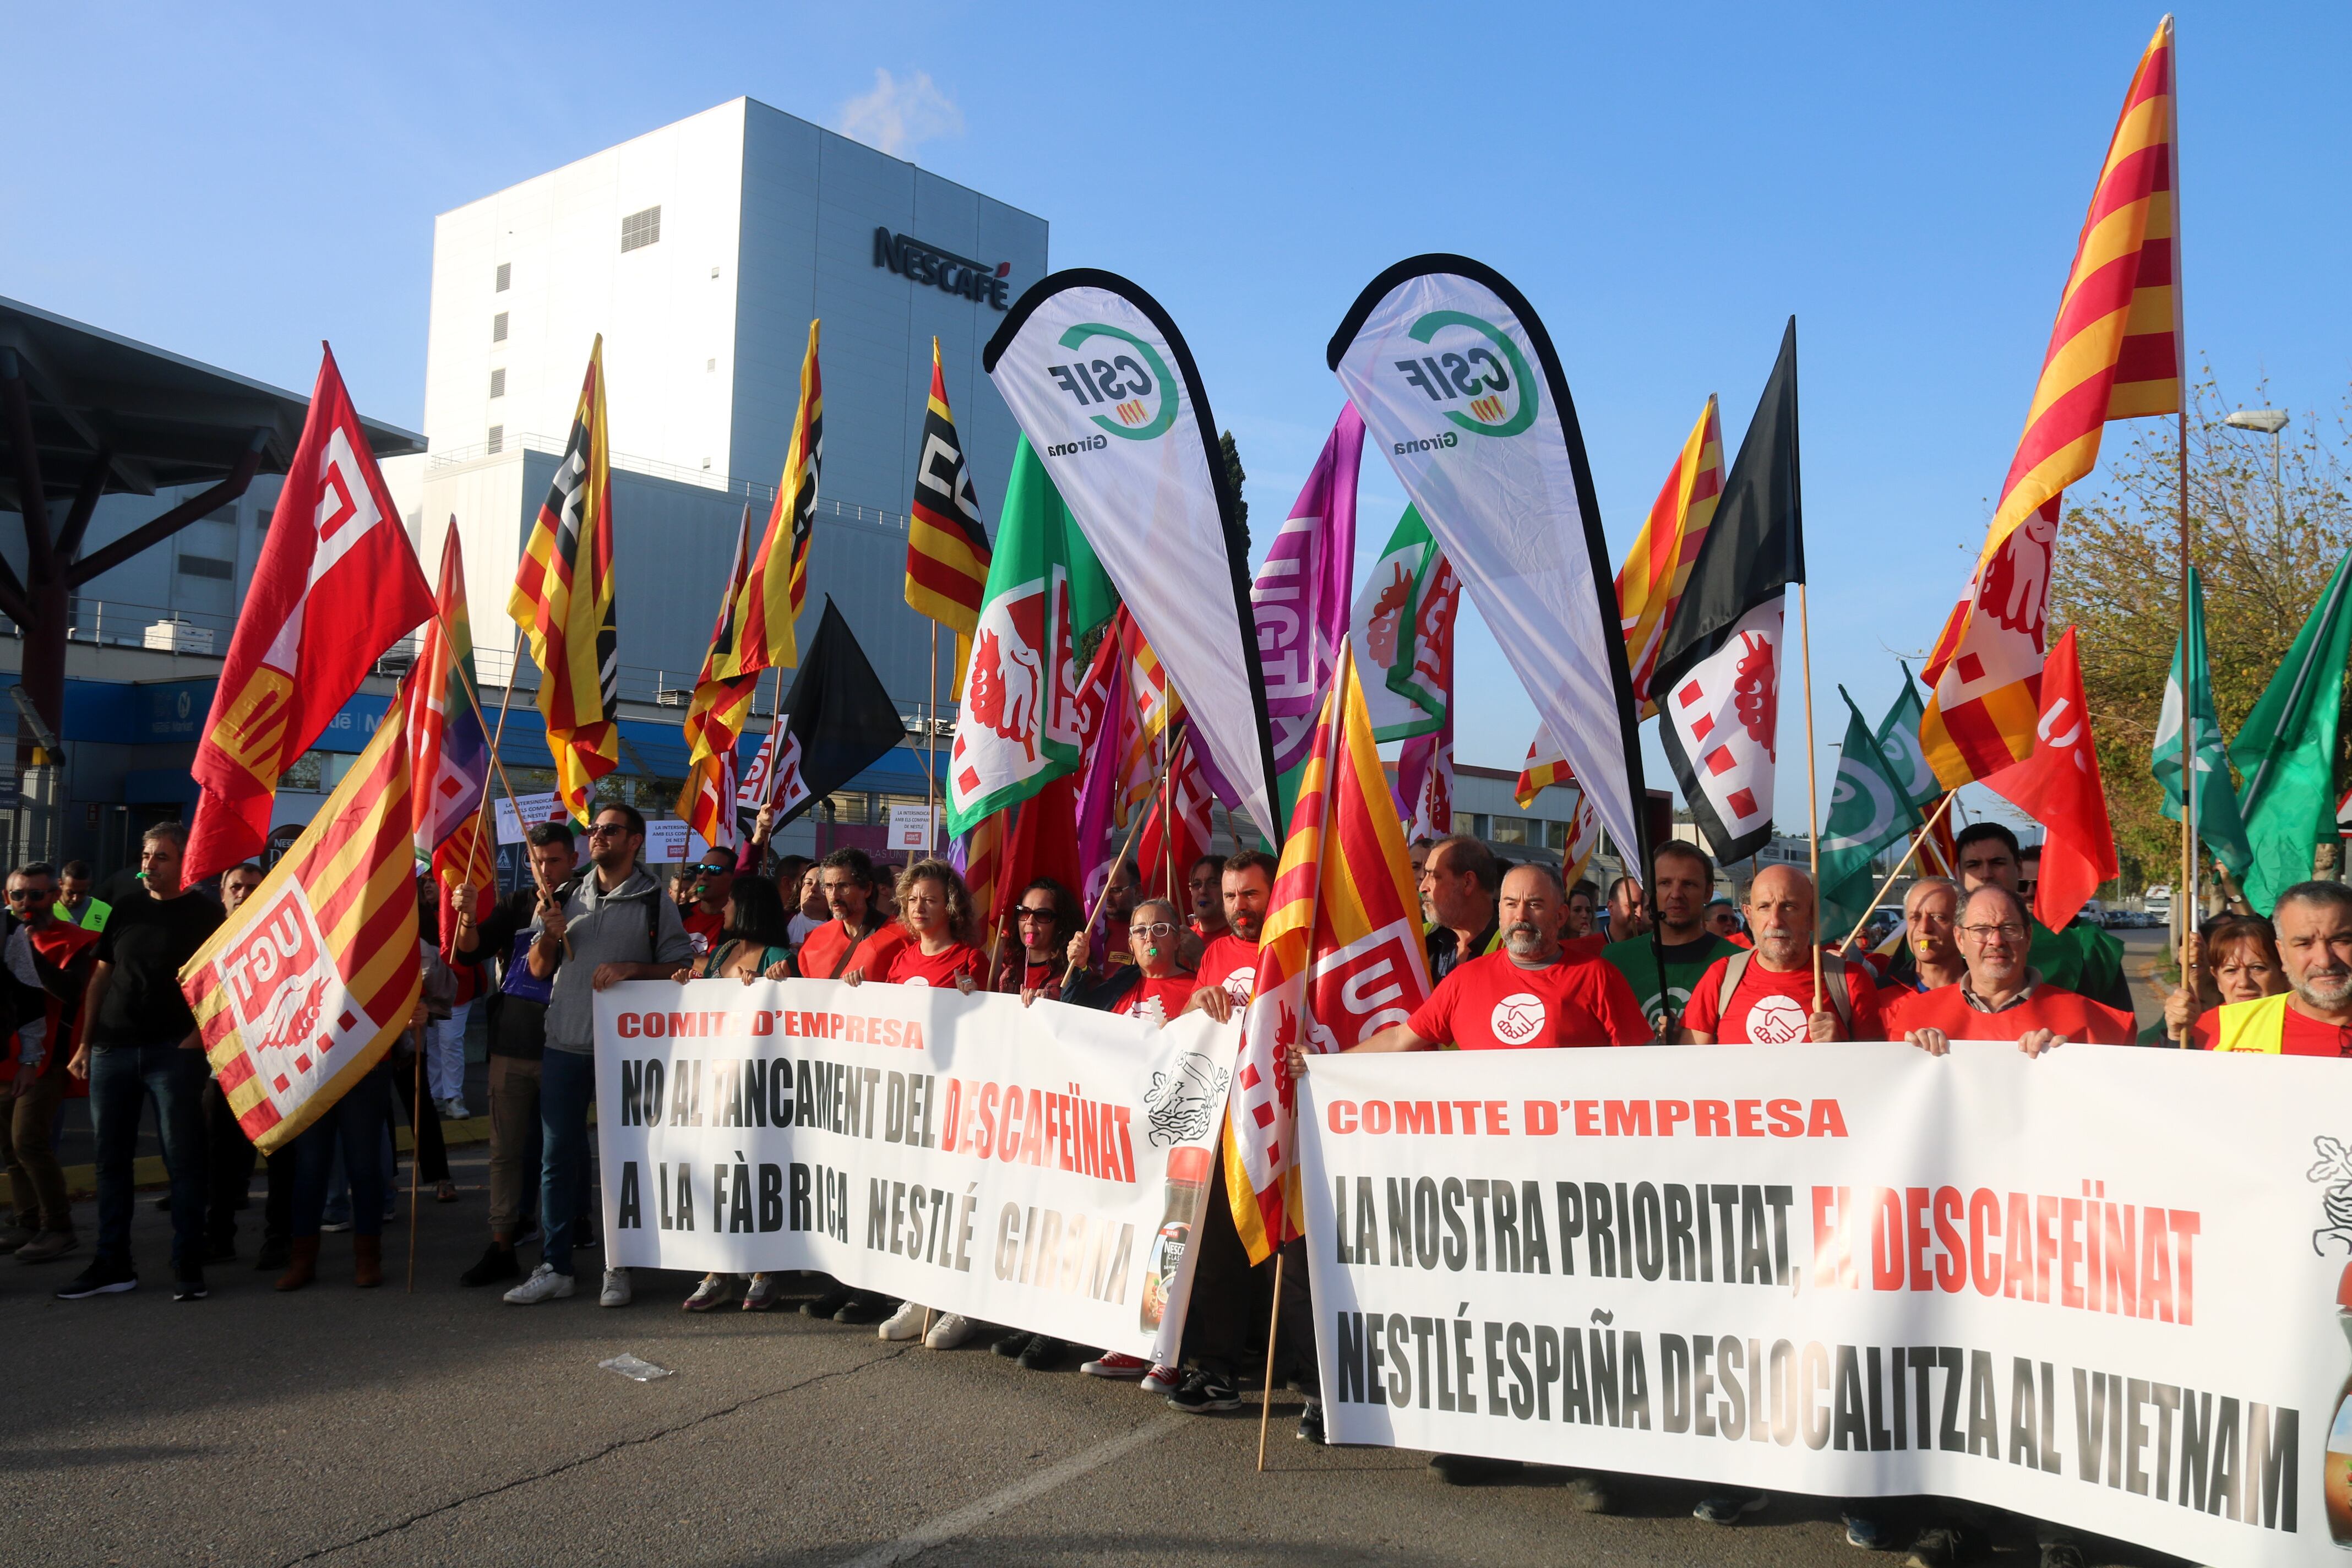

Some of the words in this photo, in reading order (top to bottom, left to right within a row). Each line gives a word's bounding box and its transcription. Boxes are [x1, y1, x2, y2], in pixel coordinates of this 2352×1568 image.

[873, 226, 1010, 311] NESCAFÉ
[518, 798, 552, 806] NTERSINDICA
[617, 1011, 742, 1038] COMITE
[750, 1010, 924, 1050] D'EMPRESA
[622, 1058, 665, 1128] NO
[669, 1059, 703, 1127] AL
[711, 1058, 880, 1139] TANCAMENT
[885, 1070, 935, 1149] DEL
[941, 1077, 1136, 1183] DESCAFEÏNAT
[1327, 1099, 1510, 1136] COMITE
[1525, 1099, 1849, 1138] D'EMPRESA
[618, 1161, 641, 1229] A
[659, 1162, 695, 1231] LA
[714, 1150, 848, 1244] FÀBRICA
[867, 1177, 978, 1273] NESTLÉ
[994, 1201, 1135, 1306] GIRONA
[1336, 1175, 1380, 1266] LA
[1386, 1175, 1551, 1276] NOSTRA
[1556, 1180, 1801, 1299] PRIORITAT,
[1811, 1185, 1859, 1291] EL
[1871, 1179, 2201, 1326] DESCAFEÏNAT
[1338, 1302, 1477, 1414] NESTLÉ
[1484, 1308, 1652, 1431] ESPAÑA
[1659, 1332, 2000, 1460] DESLOCALITZA
[2009, 1356, 2062, 1476] AL
[2072, 1366, 2299, 1534] VIETNAM
